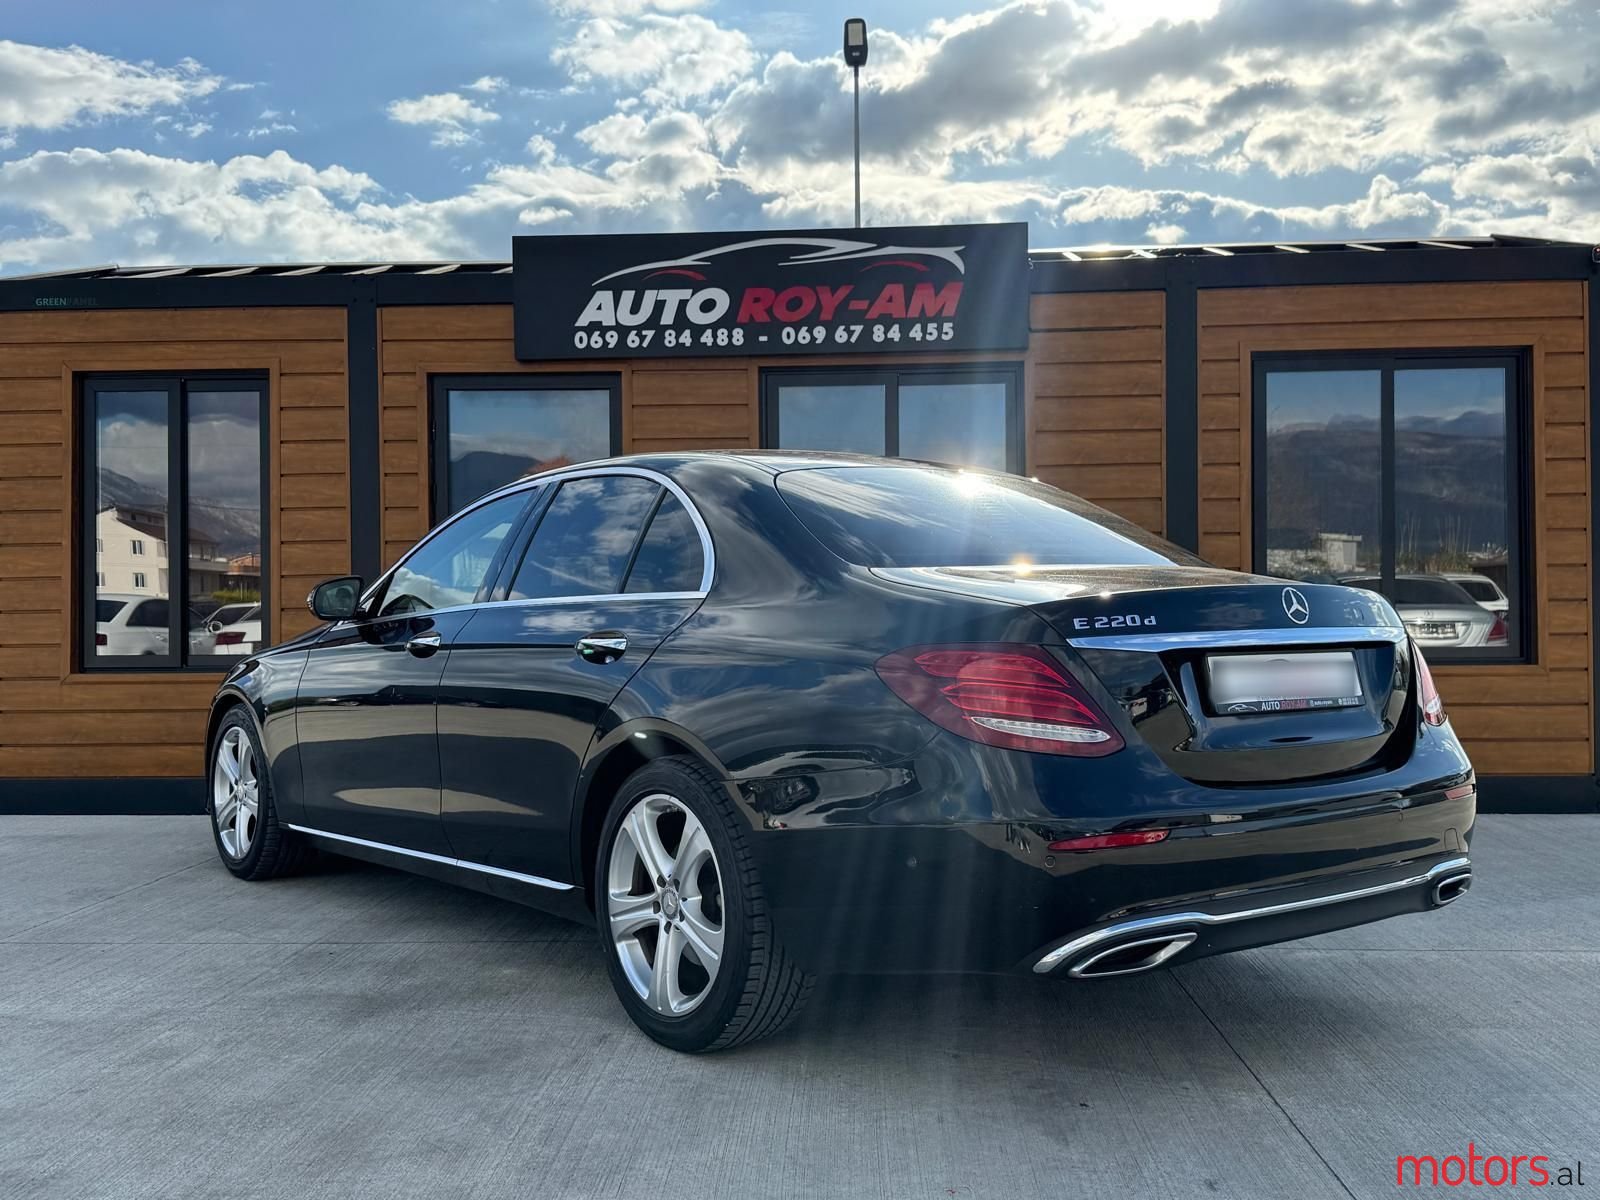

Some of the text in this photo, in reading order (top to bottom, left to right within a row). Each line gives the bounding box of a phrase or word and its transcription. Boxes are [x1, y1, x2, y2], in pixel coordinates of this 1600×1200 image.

[574, 282, 964, 326] AUTO ROY-AM
[574, 331, 618, 349] 069
[626, 330, 656, 348] 67
[664, 329, 693, 347] 84
[700, 328, 744, 346] 488
[781, 326, 827, 345] 069
[834, 325, 864, 343] 67
[872, 324, 901, 342] 84
[908, 322, 954, 341] 455
[1073, 617, 1090, 630] E
[1261, 701, 1280, 711] AUTO
